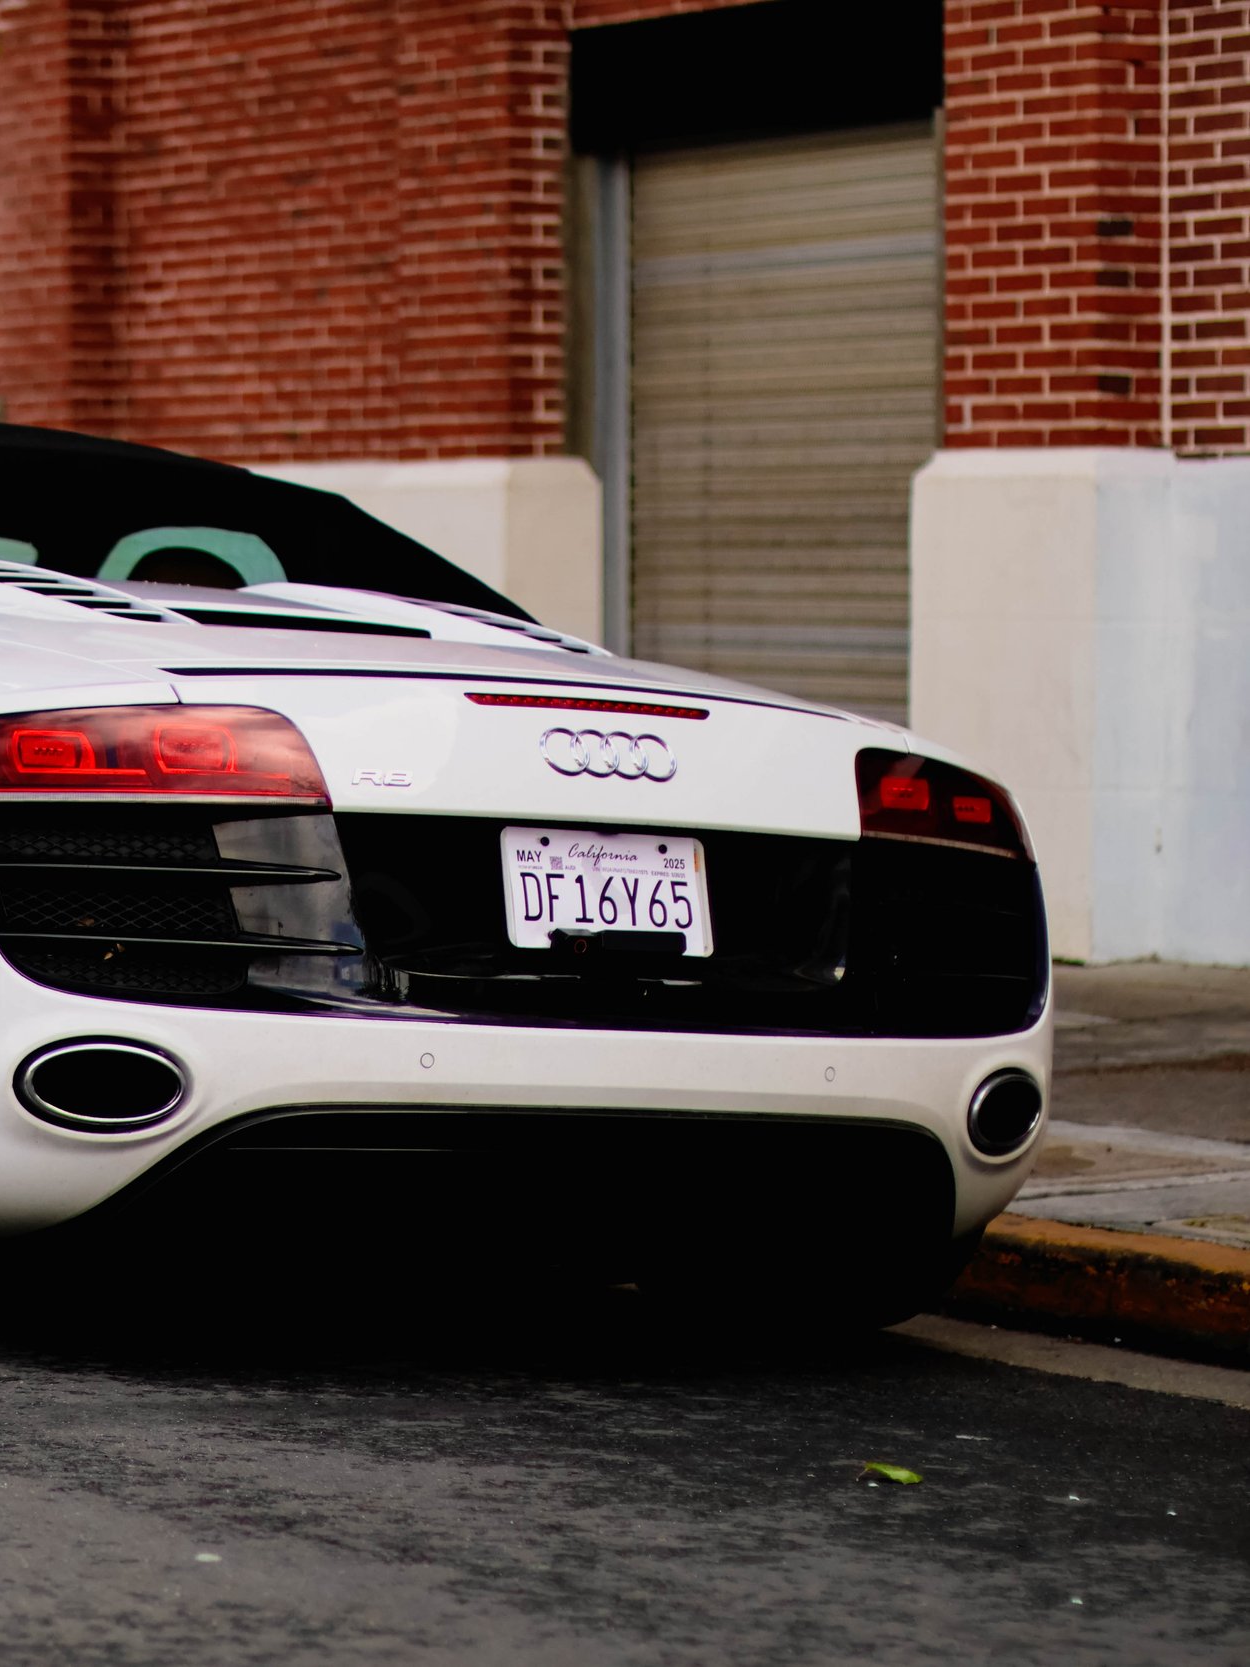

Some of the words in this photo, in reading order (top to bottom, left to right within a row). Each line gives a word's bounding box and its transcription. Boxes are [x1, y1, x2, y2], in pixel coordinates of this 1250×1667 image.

[351, 768, 413, 787] R8
[516, 850, 542, 863] MAY
[568, 843, 638, 866] California
[663, 858, 686, 870] 2025
[519, 871, 693, 930] DF16Y65
